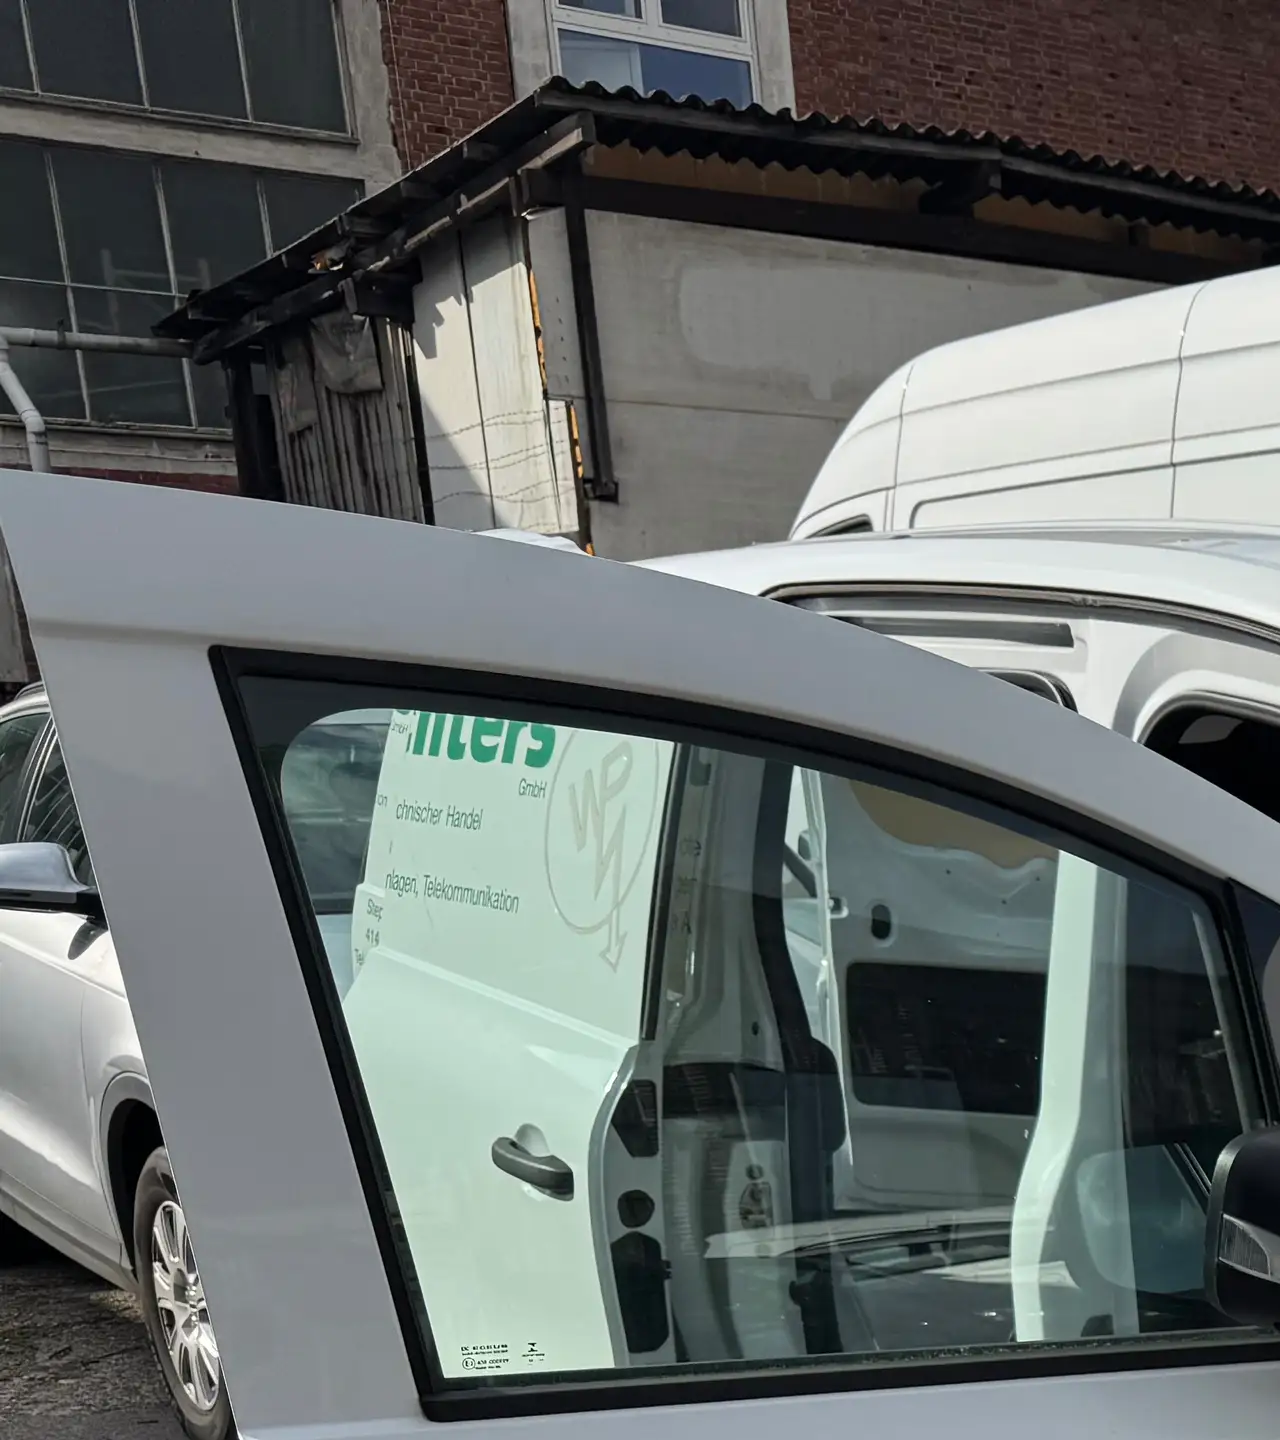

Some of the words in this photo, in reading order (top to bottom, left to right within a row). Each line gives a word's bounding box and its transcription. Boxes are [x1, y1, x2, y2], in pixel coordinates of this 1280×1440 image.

[519, 778, 547, 799] GmbH
[446, 805, 483, 830] Handel
[423, 874, 519, 914] Telekommunikation
